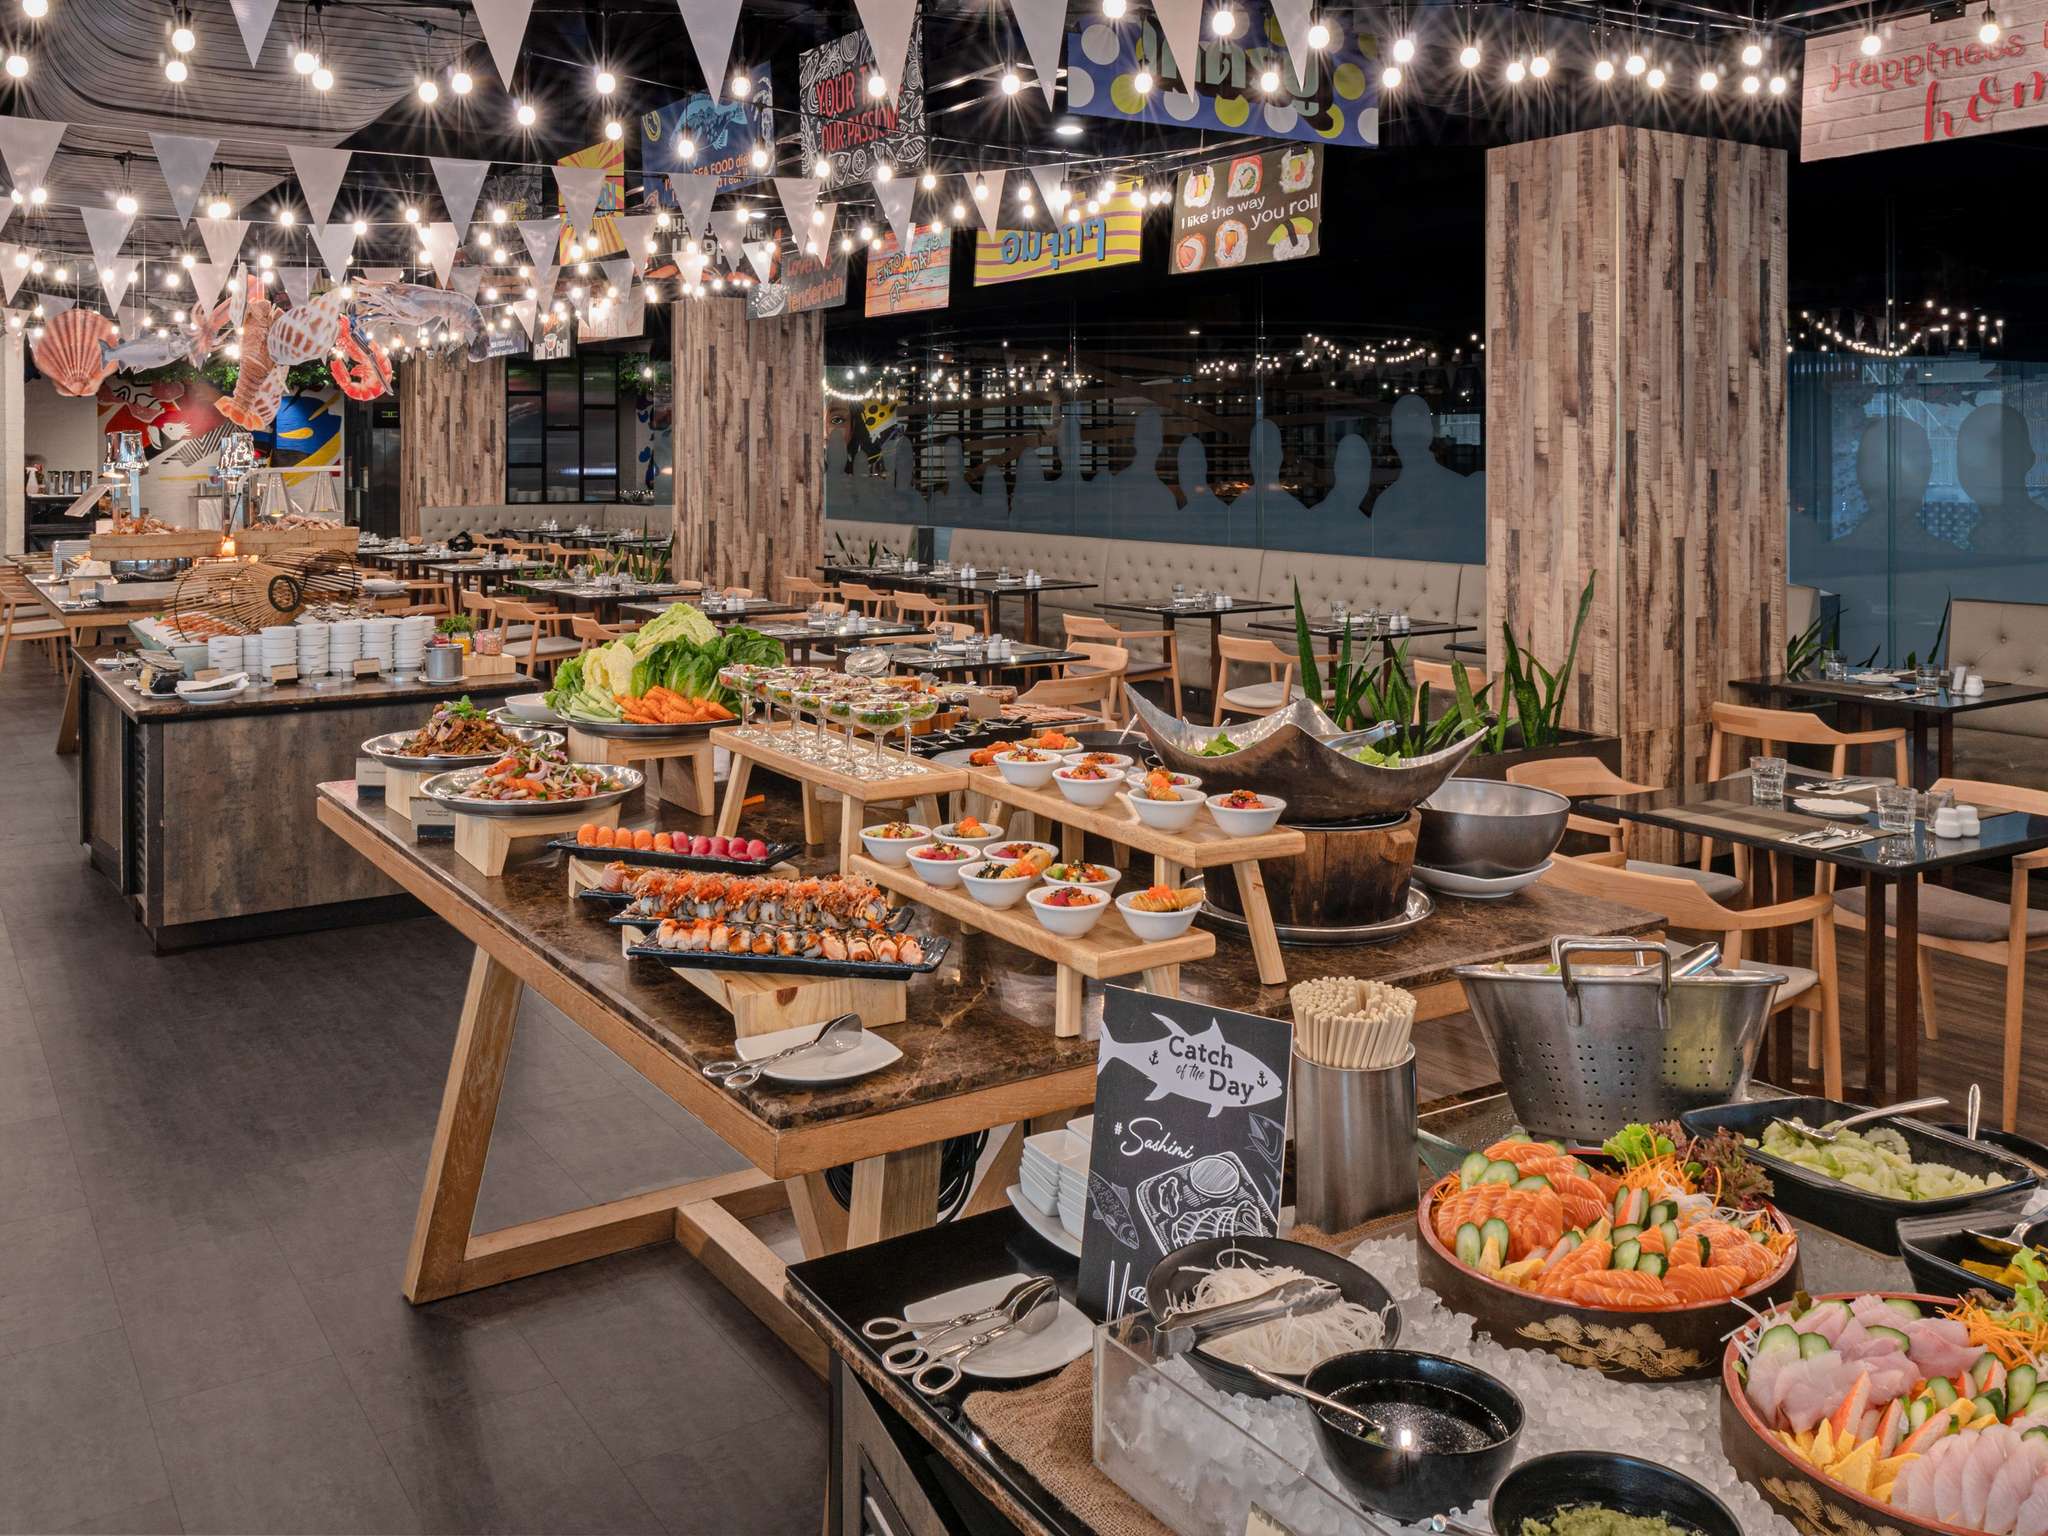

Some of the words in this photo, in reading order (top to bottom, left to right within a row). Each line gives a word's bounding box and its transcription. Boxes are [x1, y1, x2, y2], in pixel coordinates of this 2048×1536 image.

[1828, 34, 2026, 92] Happiness
[816, 71, 856, 117] YOUR
[821, 120, 845, 151] OUR
[711, 157, 734, 174] FOOD
[1181, 218, 1185, 230] I
[1187, 213, 1208, 227] like
[1212, 205, 1234, 220] the
[1237, 196, 1266, 213] way
[1250, 206, 1284, 231] you
[1289, 192, 1319, 216] roll
[1169, 1035, 1233, 1069] Catch
[1176, 1064, 1185, 1080] of
[1189, 1065, 1205, 1081] the
[1209, 1070, 1254, 1105] Day
